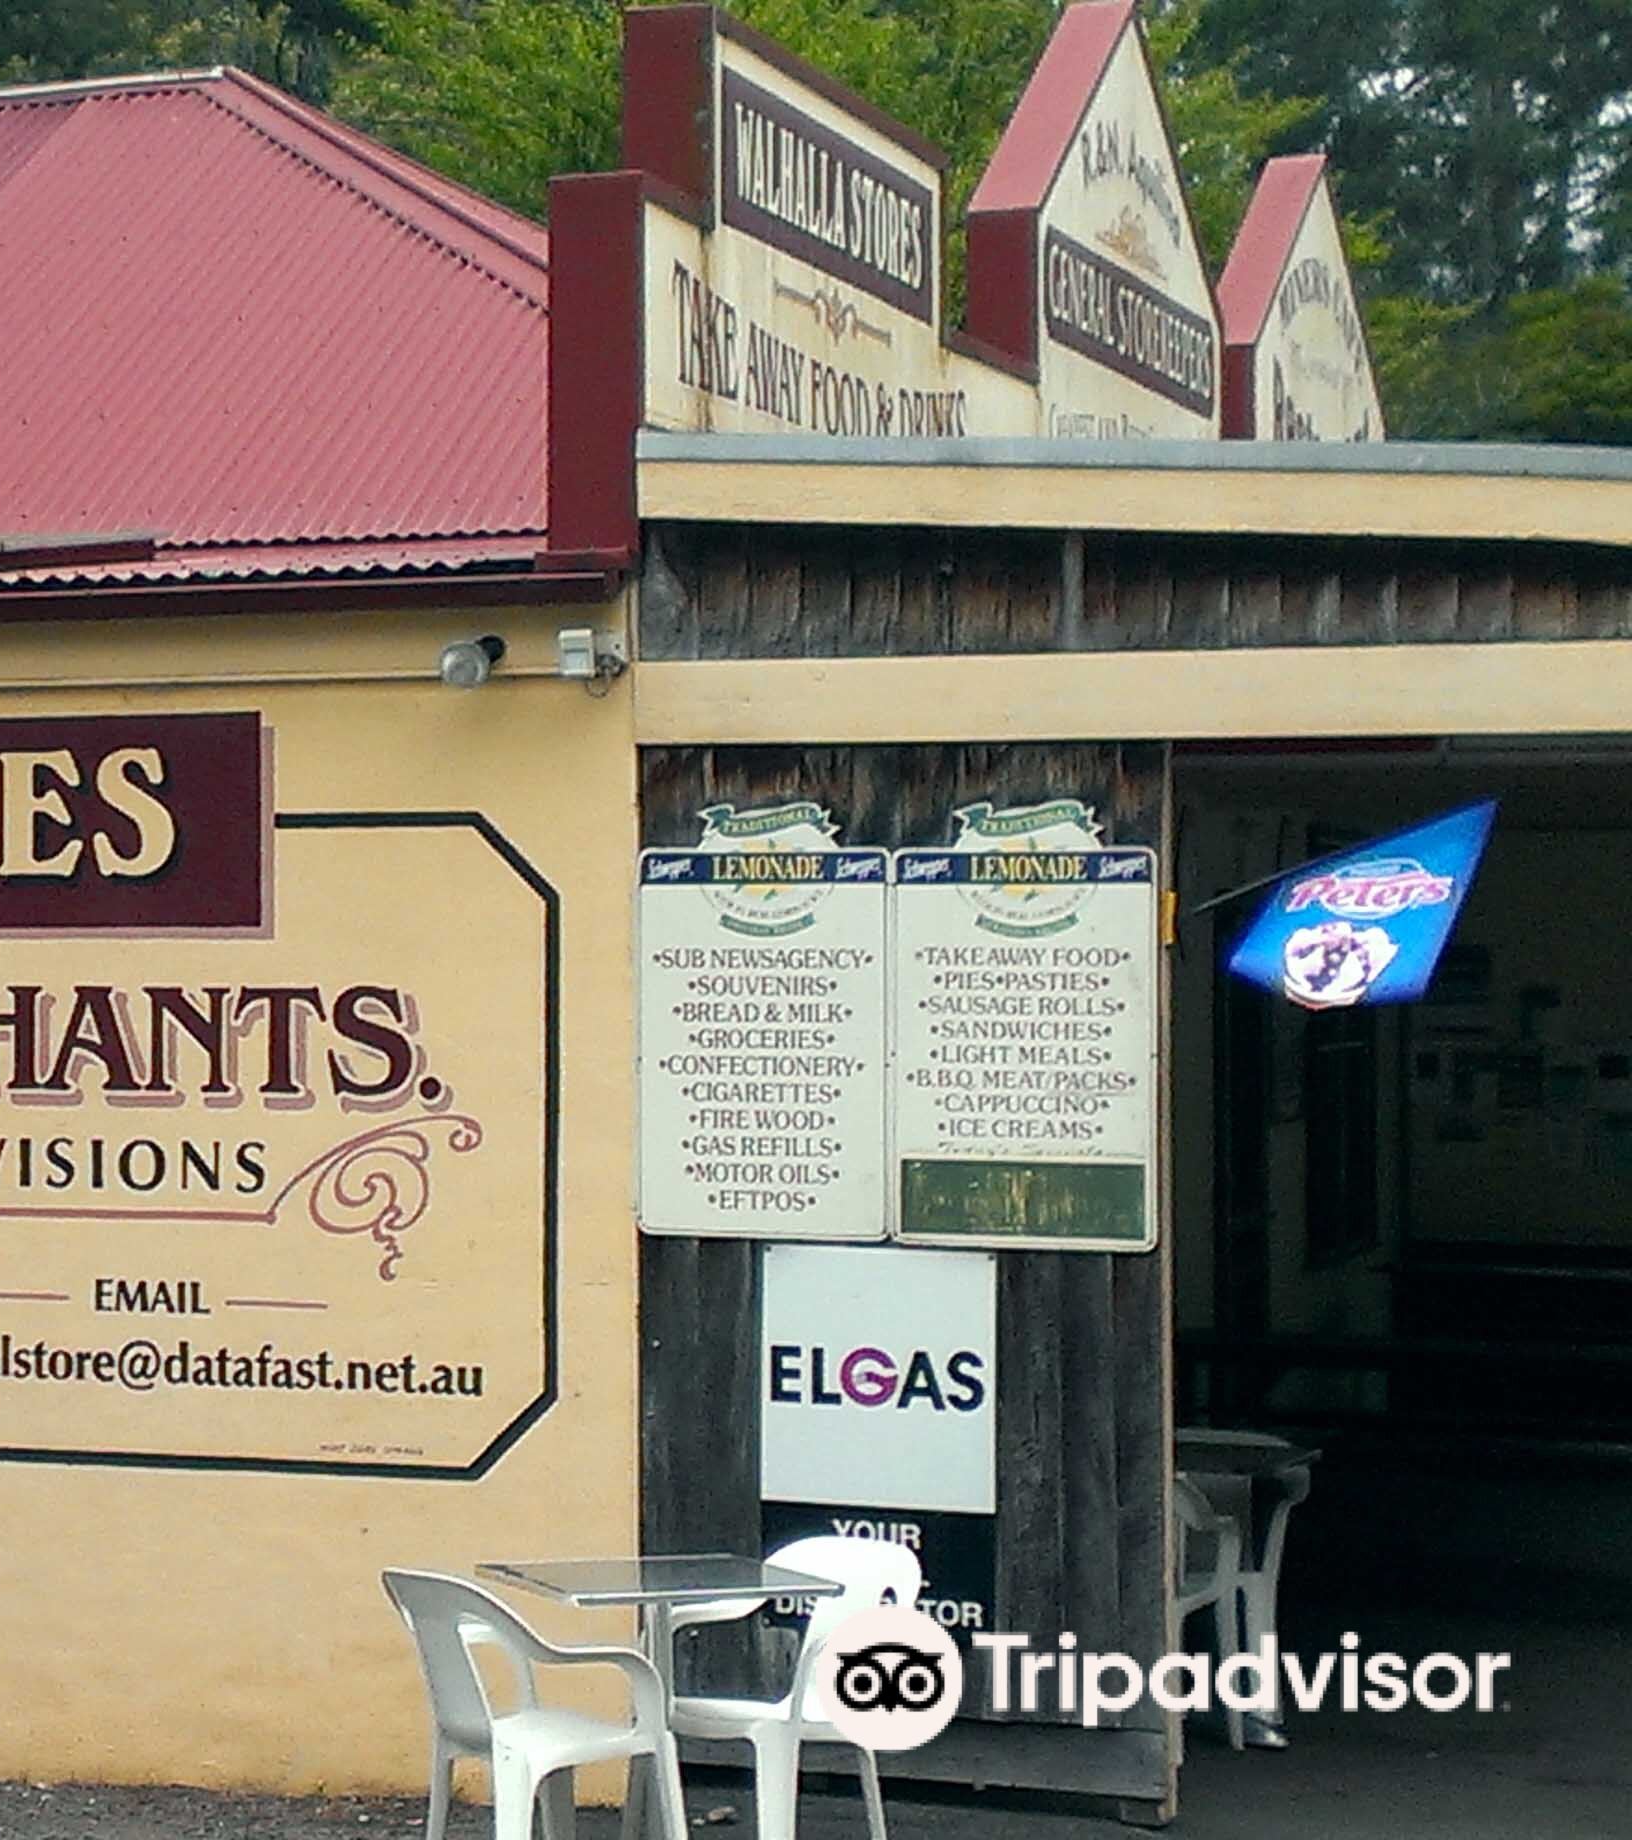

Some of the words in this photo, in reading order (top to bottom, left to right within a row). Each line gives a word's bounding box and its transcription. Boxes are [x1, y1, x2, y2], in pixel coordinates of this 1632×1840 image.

[735, 102, 847, 250] WALHALLA
[849, 168, 922, 290] STORES
[1049, 244, 1115, 345] GENERAL
[671, 258, 739, 400] TAKE
[745, 320, 805, 426] AWAY
[810, 359, 872, 436] FOOD
[711, 855, 824, 881] LEMONADE
[970, 855, 1088, 881] LEMONADE
[1285, 868, 1454, 914] Peters
[660, 949, 705, 969] SUB
[711, 949, 866, 970] NEWSAGENCY
[1052, 947, 1120, 967] FOOD
[697, 975, 828, 996] SOUVENIRS
[683, 1001, 760, 1023] BREAD
[764, 1003, 783, 1023] &
[788, 1003, 844, 1023] MILK
[928, 995, 1033, 1016] SAUSAGE
[1039, 996, 1117, 1017] ROLLS
[697, 1028, 826, 1049] GROCERIES
[940, 1020, 1103, 1041] SANDWICHES
[668, 1054, 857, 1077] CONFECTIONERY
[940, 1044, 1011, 1065] LIGHT
[1018, 1045, 1103, 1066] MEALS
[691, 1081, 833, 1103] CIGARETTES
[944, 1092, 1099, 1115] CAPPUCCINO
[949, 1117, 986, 1138] ICE
[991, 1118, 1093, 1140] CREAMS
[692, 1135, 736, 1157] GAS
[741, 1136, 833, 1158] REFILLS
[694, 1162, 773, 1184] MOTOR
[779, 1163, 831, 1185] OILS
[719, 1189, 806, 1212] EFTPOS
[93, 1277, 212, 1316] EMAIL
[770, 1344, 985, 1412] ELGAS
[831, 1518, 922, 1550] YOUR
